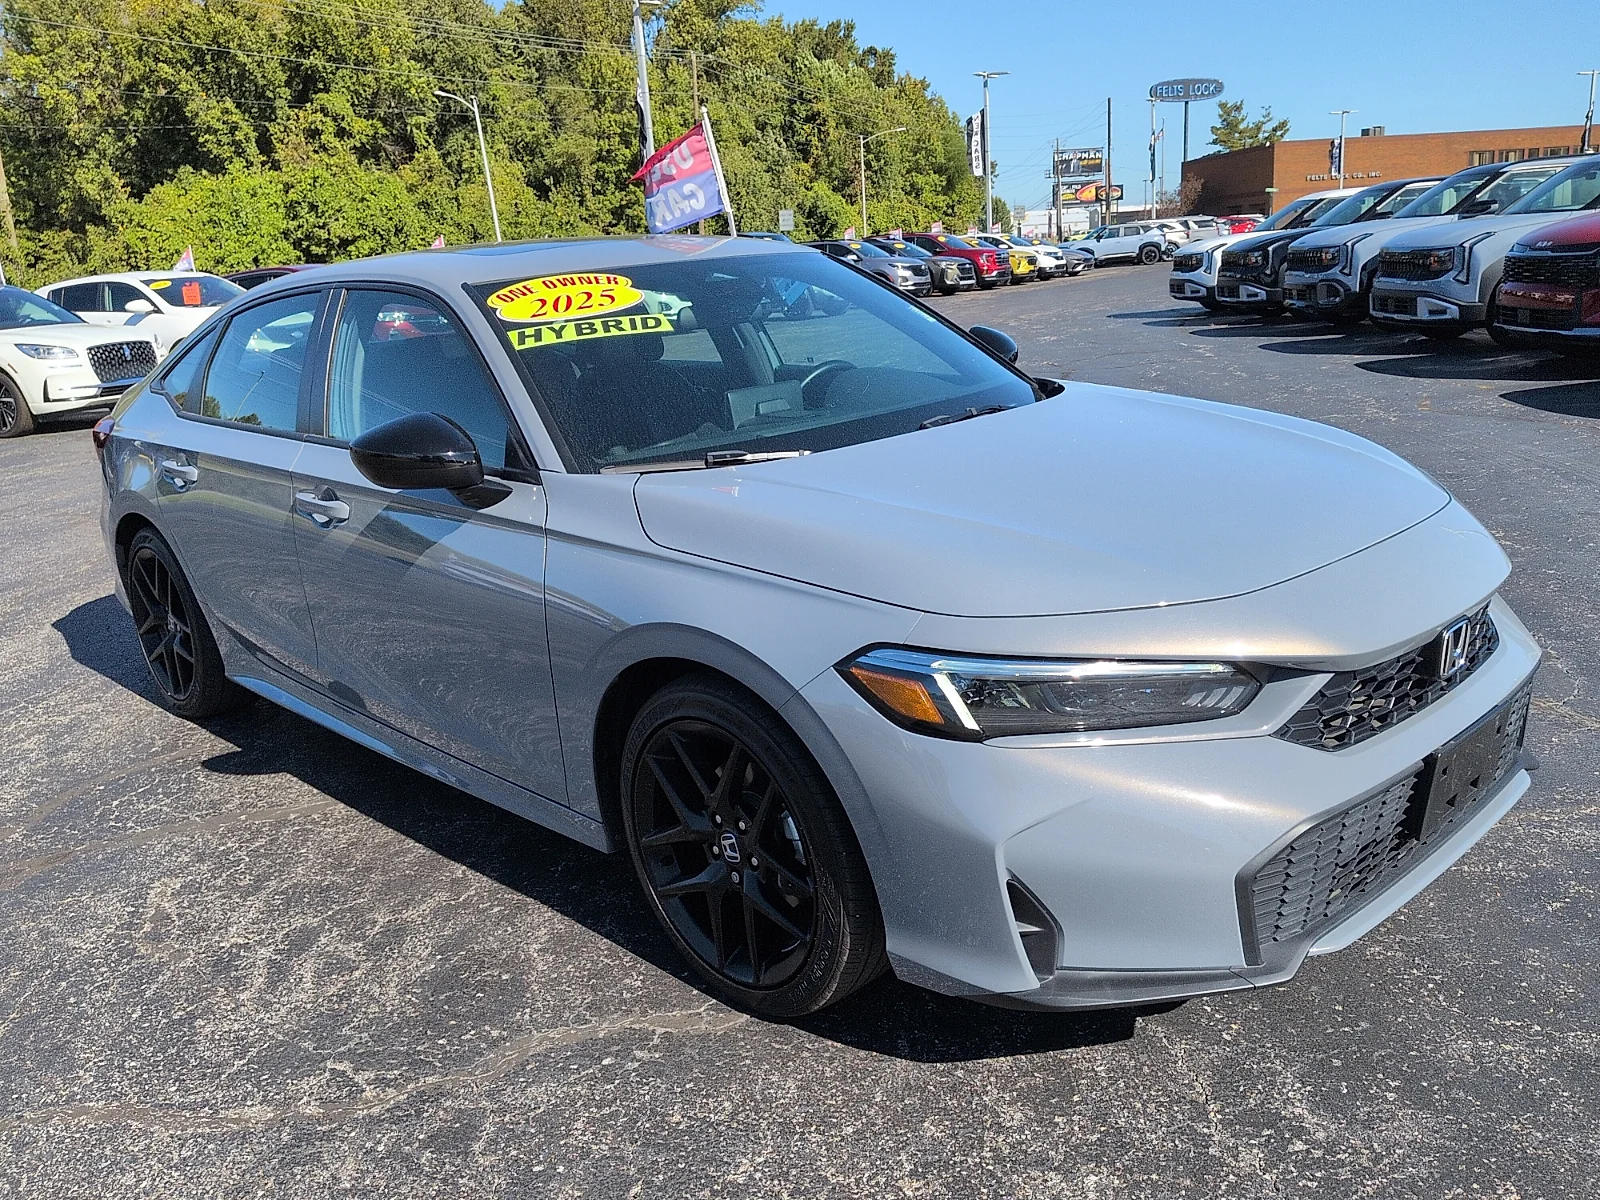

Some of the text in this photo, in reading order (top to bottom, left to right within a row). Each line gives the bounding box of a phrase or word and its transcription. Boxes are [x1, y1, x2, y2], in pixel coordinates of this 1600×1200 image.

[1156, 84, 1184, 97] FELTS
[495, 275, 620, 304] ONE OWNER
[529, 289, 616, 319] 2025
[517, 316, 663, 346] HYBRID
